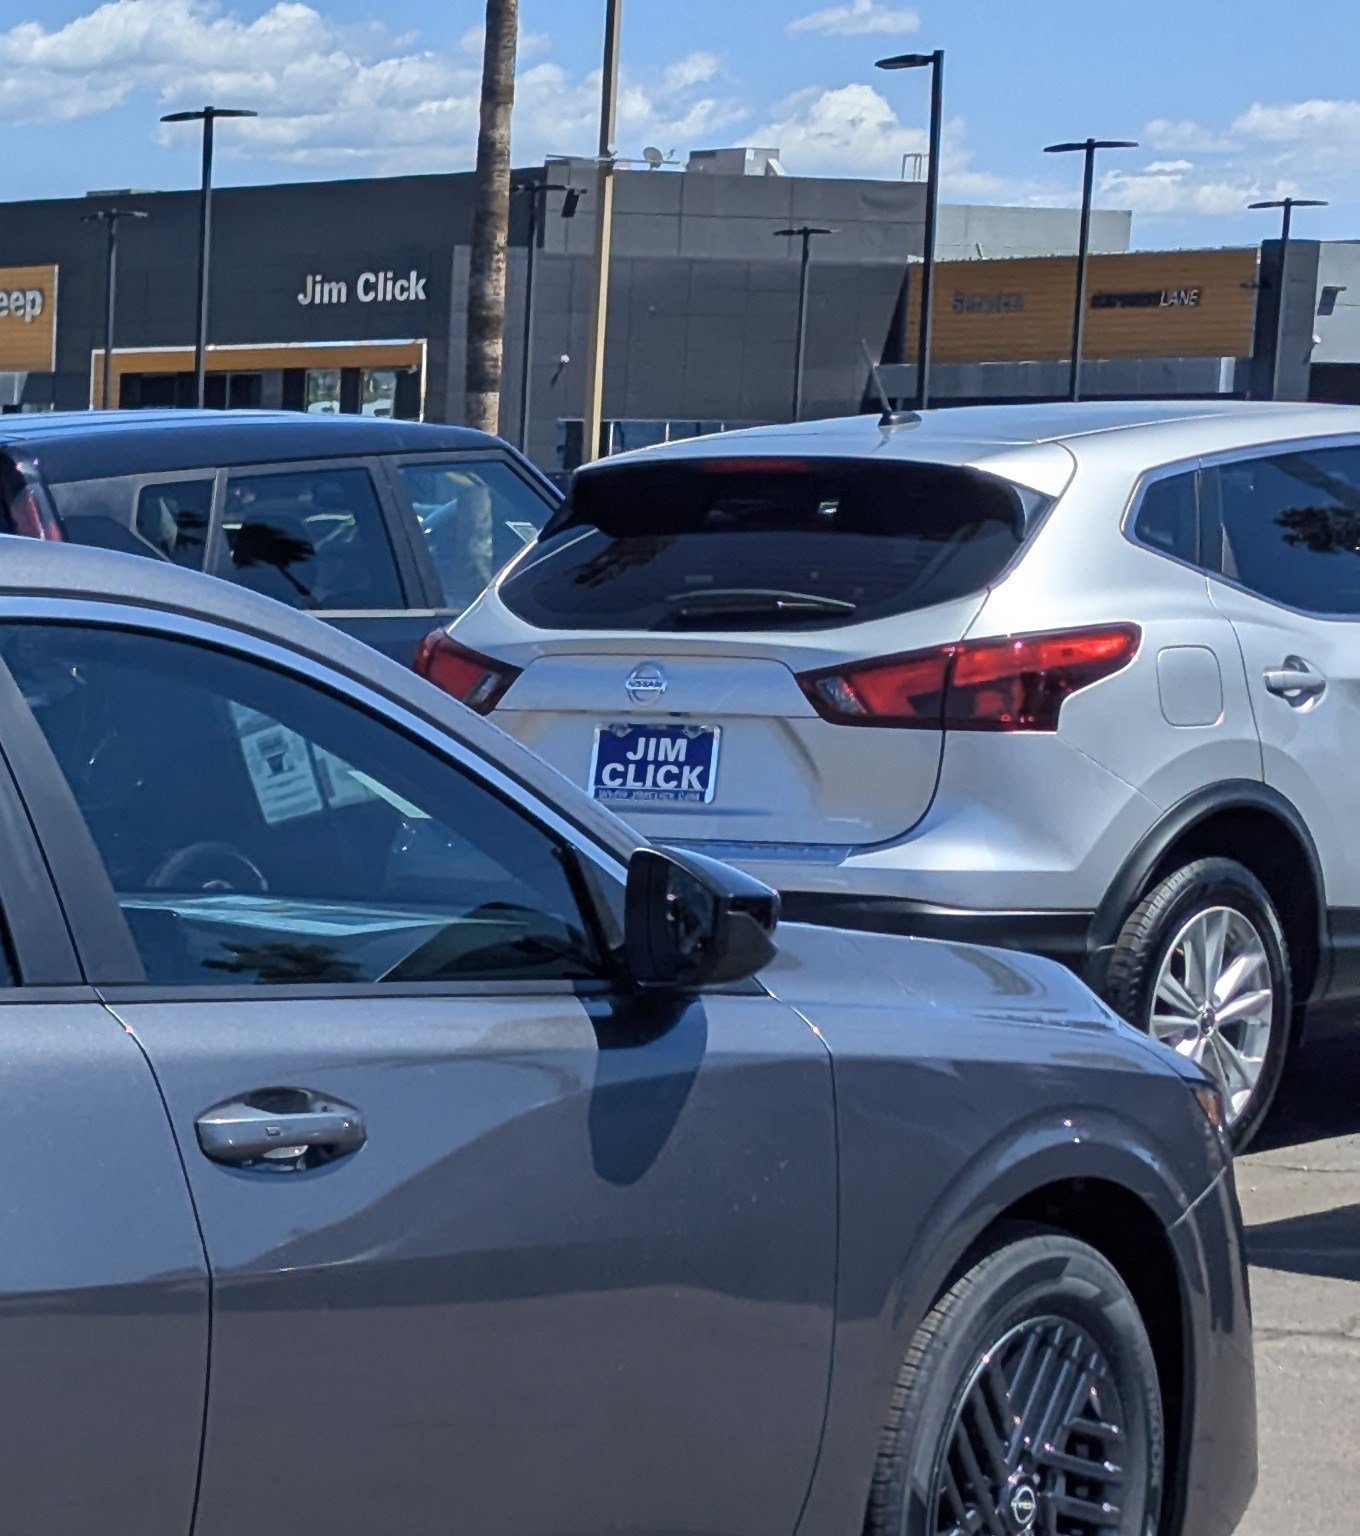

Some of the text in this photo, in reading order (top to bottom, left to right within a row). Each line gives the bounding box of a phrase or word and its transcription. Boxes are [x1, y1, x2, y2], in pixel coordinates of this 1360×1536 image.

[297, 270, 428, 305] Jim Click
[1159, 288, 1200, 308] LANE
[626, 737, 688, 762] JIM
[601, 762, 705, 790] CLICK
